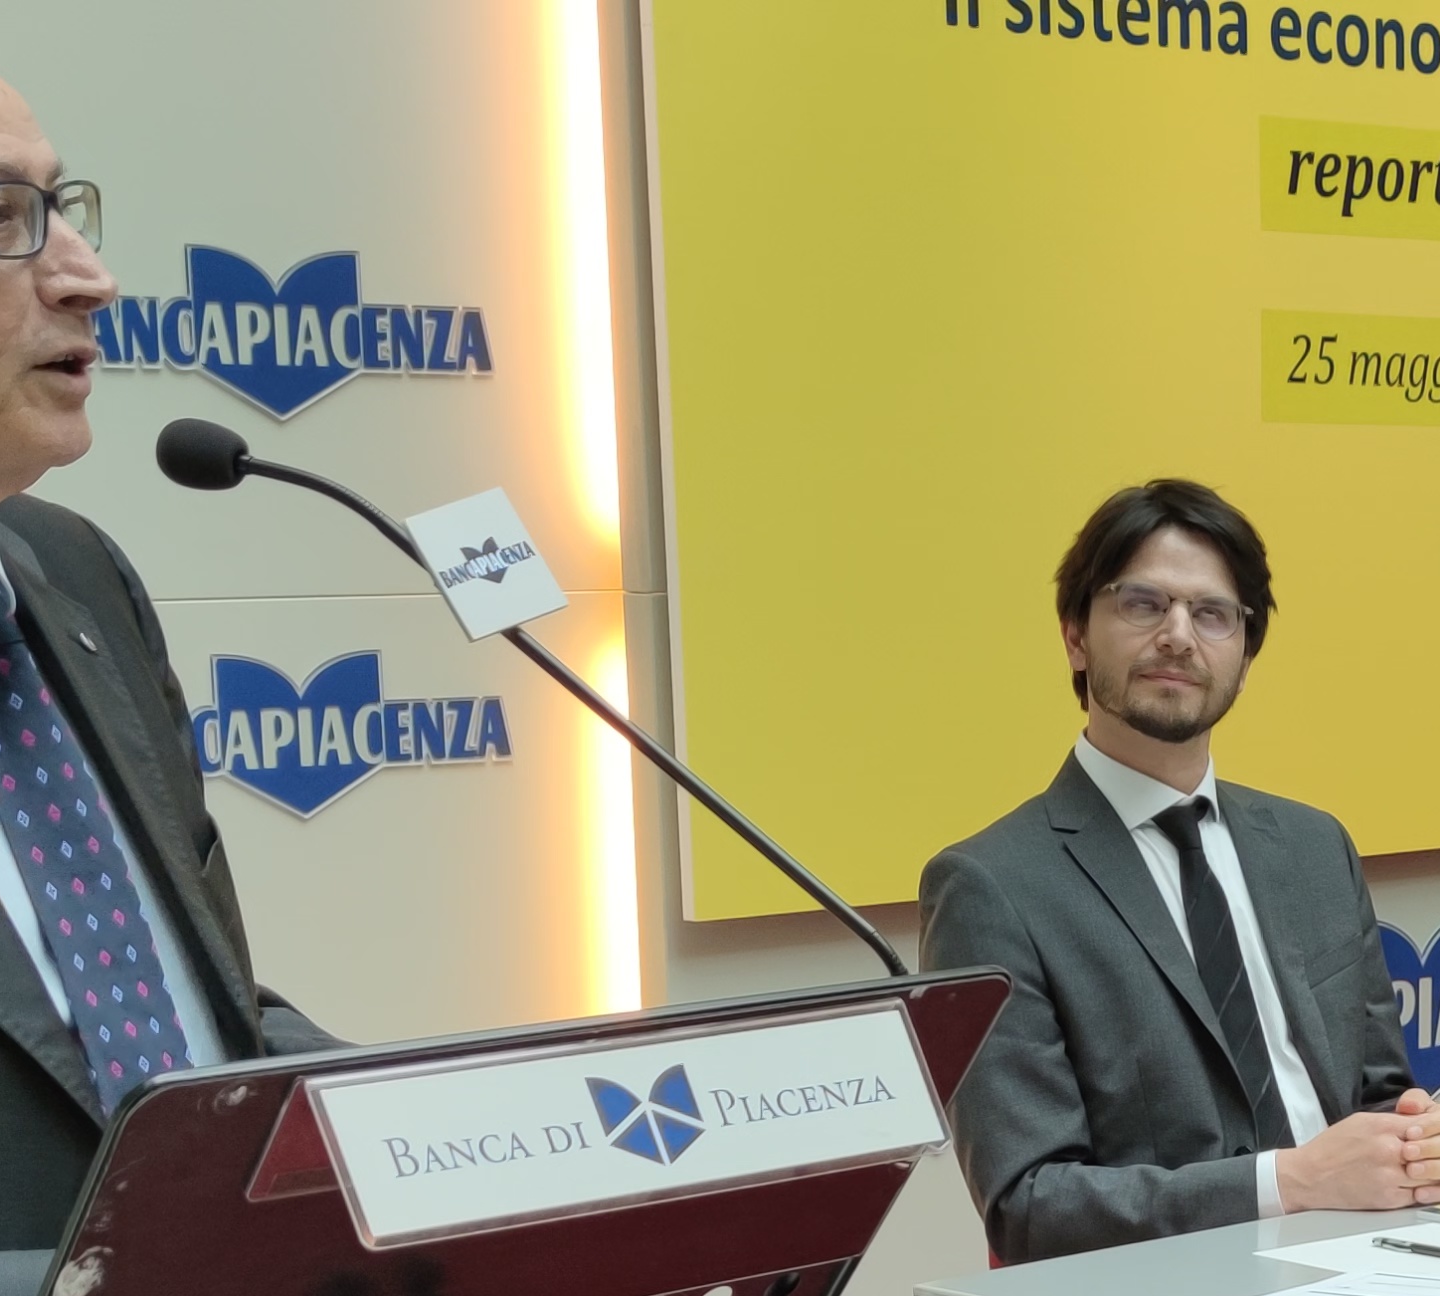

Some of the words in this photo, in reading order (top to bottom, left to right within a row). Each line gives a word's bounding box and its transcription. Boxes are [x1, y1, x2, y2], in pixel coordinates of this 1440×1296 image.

[94, 299, 492, 371] ANCAPIACENZA
[1287, 334, 1338, 385] 25
[194, 700, 512, 773] CAPIACENZA
[383, 1130, 535, 1178] BANCA
[541, 1121, 591, 1155] DI
[709, 1075, 896, 1128] PIACENZA
